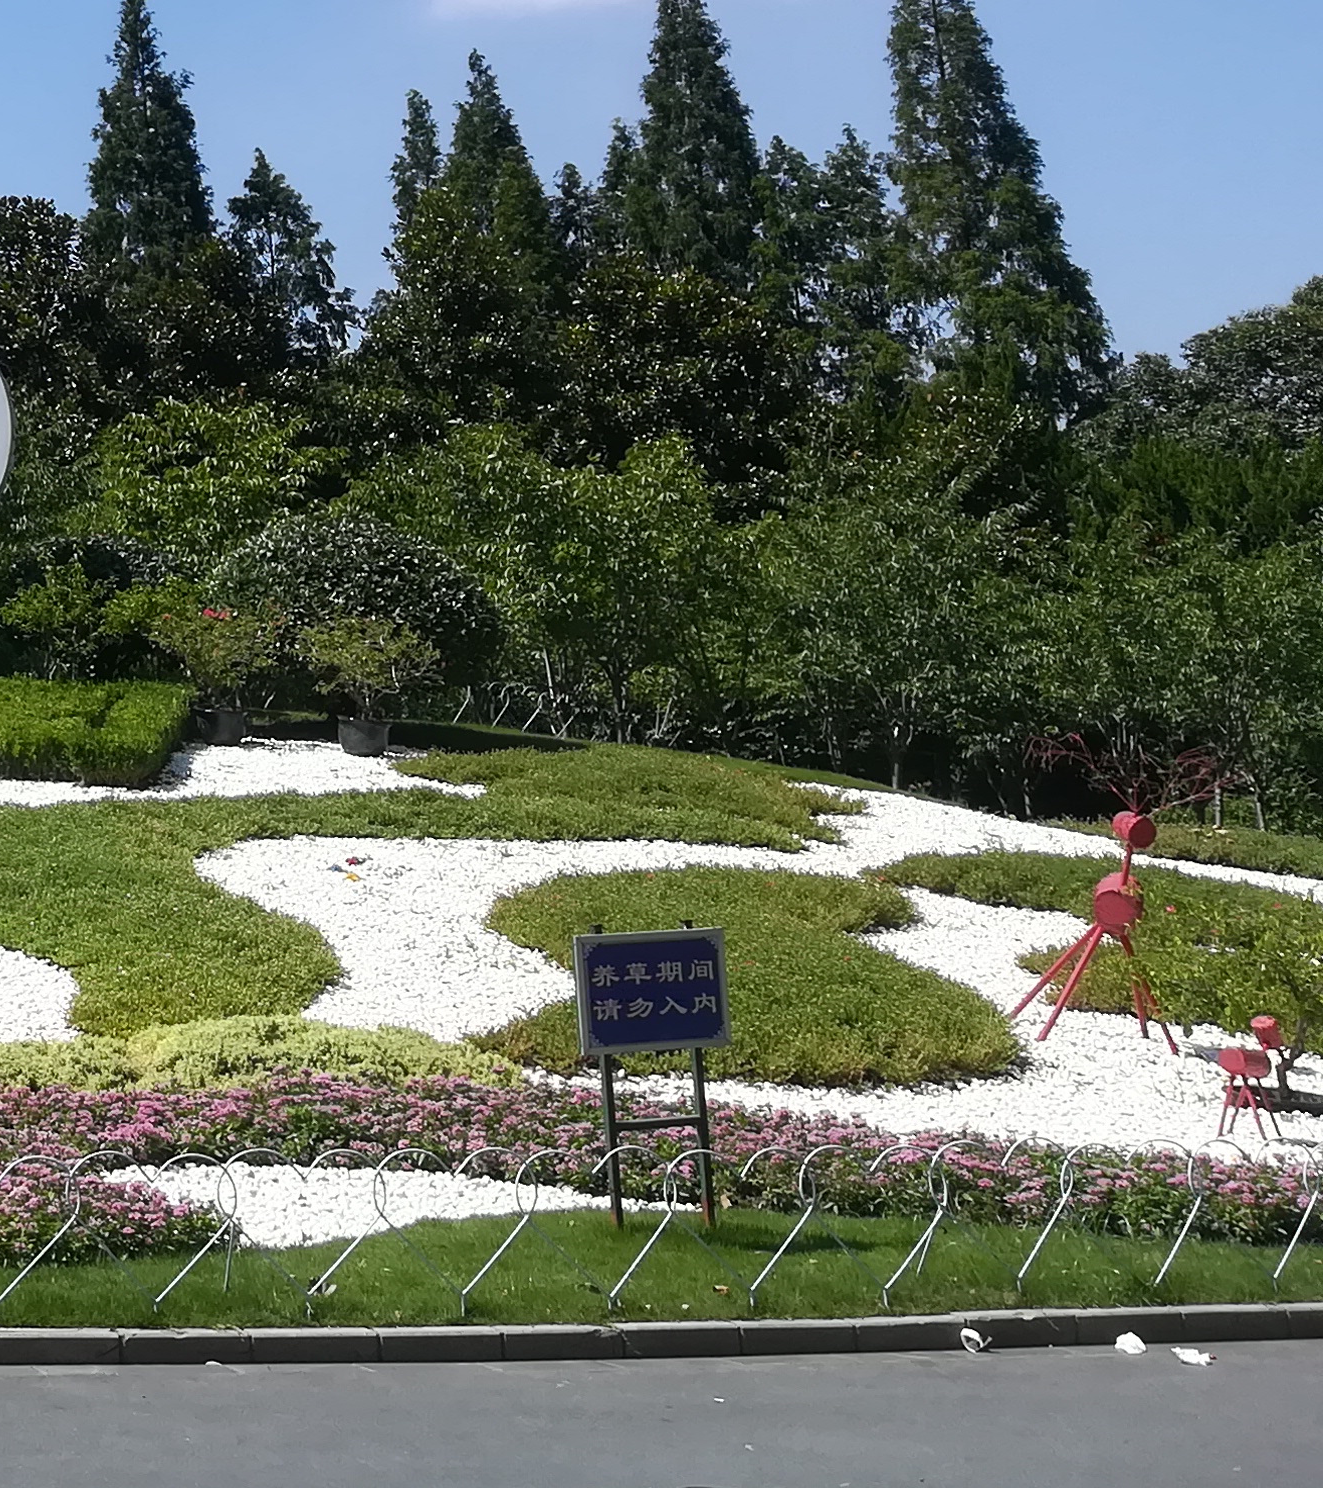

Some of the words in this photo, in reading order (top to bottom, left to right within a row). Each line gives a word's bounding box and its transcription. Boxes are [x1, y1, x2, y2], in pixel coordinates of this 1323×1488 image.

[591, 960, 714, 987] 养草期间
[593, 992, 717, 1020] 请勿入内
